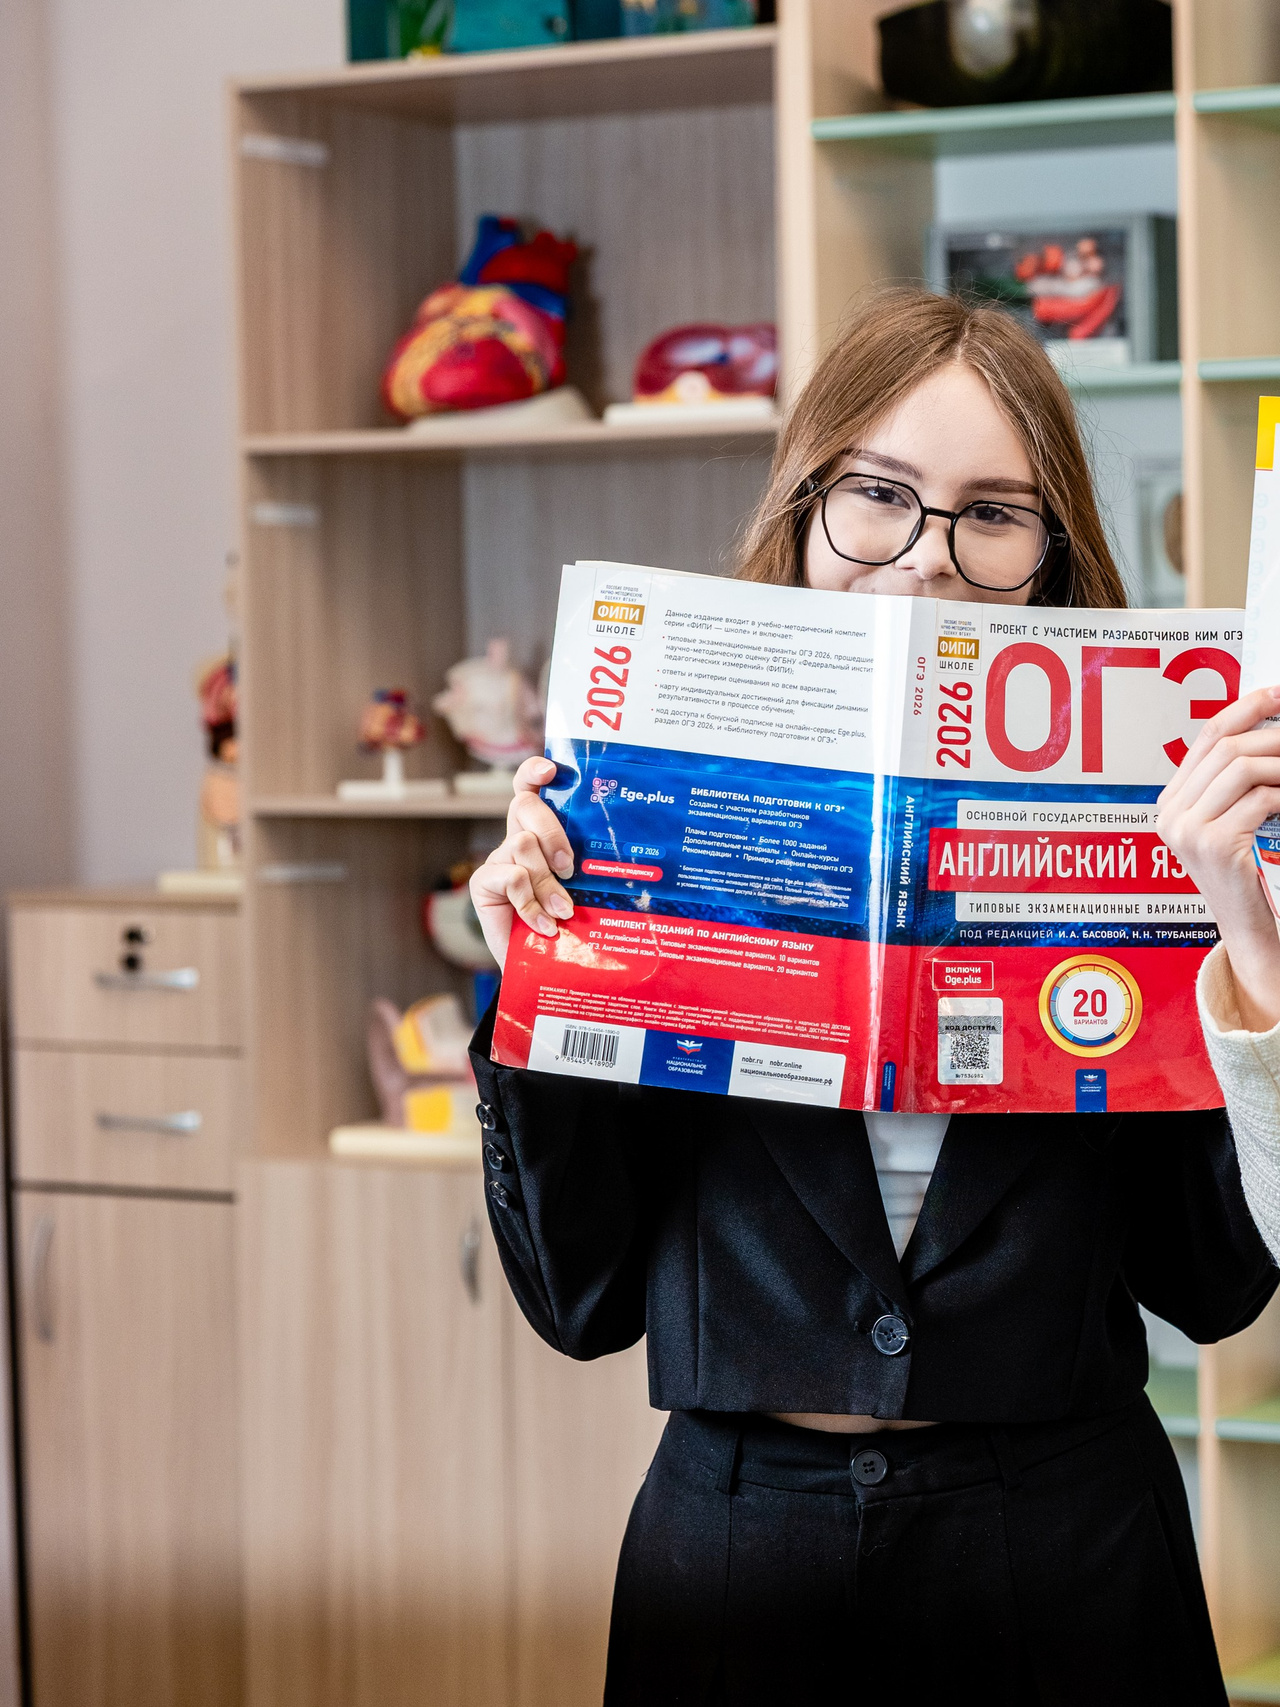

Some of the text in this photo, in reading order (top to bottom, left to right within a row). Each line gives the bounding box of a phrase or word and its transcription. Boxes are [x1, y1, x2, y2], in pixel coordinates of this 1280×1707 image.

[597, 605, 641, 621] ФИПИ
[596, 624, 636, 636] ШКОЛЕ
[664, 609, 692, 618] Данное
[693, 614, 723, 622] издание
[757, 620, 833, 634] учебно-методический
[834, 629, 866, 637] комплект
[989, 623, 1242, 640] ПРОЕКТ С УЧАСТИЕМ РАЗРАБОТЧИКОВ КИМ ОГЭ
[667, 635, 873, 663] типовые экзаменационные варианты ОГЭ 2026, прошедшие
[939, 640, 976, 656] ФИПИ
[939, 660, 974, 671] ШКОЛЕ
[582, 645, 632, 732] 2026
[912, 656, 927, 717] ОГЭ 2026
[985, 641, 1242, 773] ОГЭ
[936, 680, 974, 770] 2026
[620, 786, 674, 804] Ege.plus
[690, 787, 749, 801] БИБЛИОТЕКА
[752, 795, 811, 809] ПОДГОТОВКИ
[814, 802, 821, 810] К
[688, 798, 718, 808] Создана
[725, 805, 756, 813] участием
[758, 809, 809, 820] разработчиков
[966, 810, 1026, 821] ОСНОВНОЙ
[1032, 811, 1147, 824] ГОСУДАРСТВЕННЫЙ
[630, 845, 659, 855] ОГЭ 2026
[938, 836, 1187, 879] АНГЛИЙСКИЙ ЯЗ
[895, 794, 915, 929] АНГЛИЙСКИЙ ЯЗЫК
[970, 902, 1205, 914] ТИПОВЫЕ ЭКЗАМЕНАЦИОННЫЕ ВАРИАНТЫ
[599, 917, 813, 951] КОМПЛЕКТ ИЗДАНИЙ ПО АНГЛИЙСКОМУ ЯЗЫКУ
[959, 928, 1216, 941] ПОД РЕДАКЦИЕЙ БАСОВОЙ, ТРУБАНЕВОЙ
[589, 930, 602, 938] ОГЭ.
[603, 932, 640, 942] Английский
[641, 937, 657, 948] язык.
[660, 938, 686, 948] Типовые
[687, 943, 743, 956] экзаменационные
[744, 951, 776, 960] варианты.
[786, 956, 819, 966] вариантов
[945, 966, 982, 974] включи
[944, 975, 982, 986] Oge.plus
[1073, 989, 1108, 1017] 20
[741, 1056, 803, 1070] nobr.ru nobr.online
[740, 1067, 833, 1086] национальноеобразование.рф
